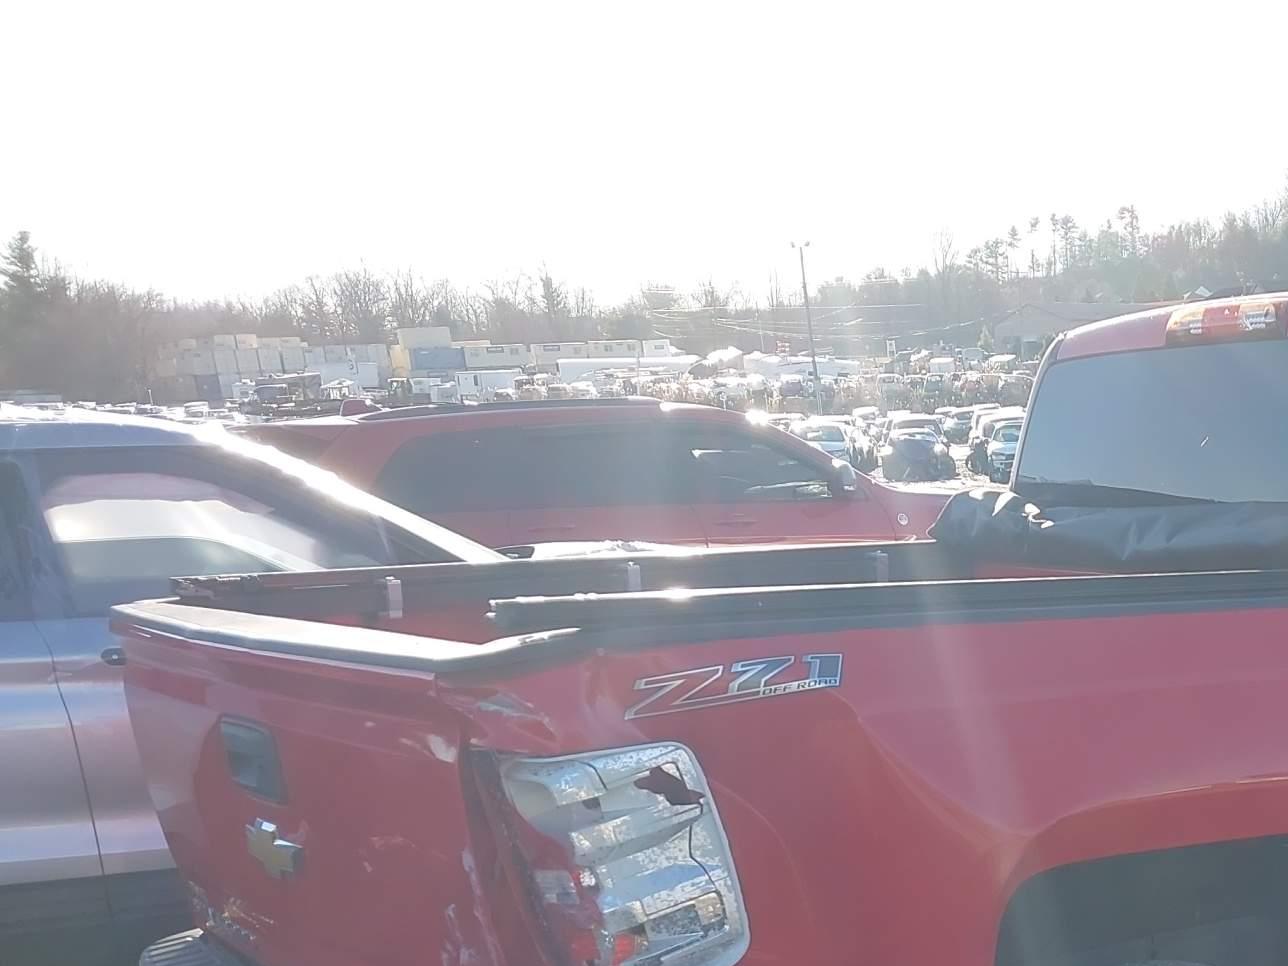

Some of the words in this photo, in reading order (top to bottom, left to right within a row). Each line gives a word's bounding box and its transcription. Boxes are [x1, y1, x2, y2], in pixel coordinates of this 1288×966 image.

[624, 653, 843, 720] Z71
[761, 685, 794, 697] OFF
[797, 678, 838, 690] ROAD
